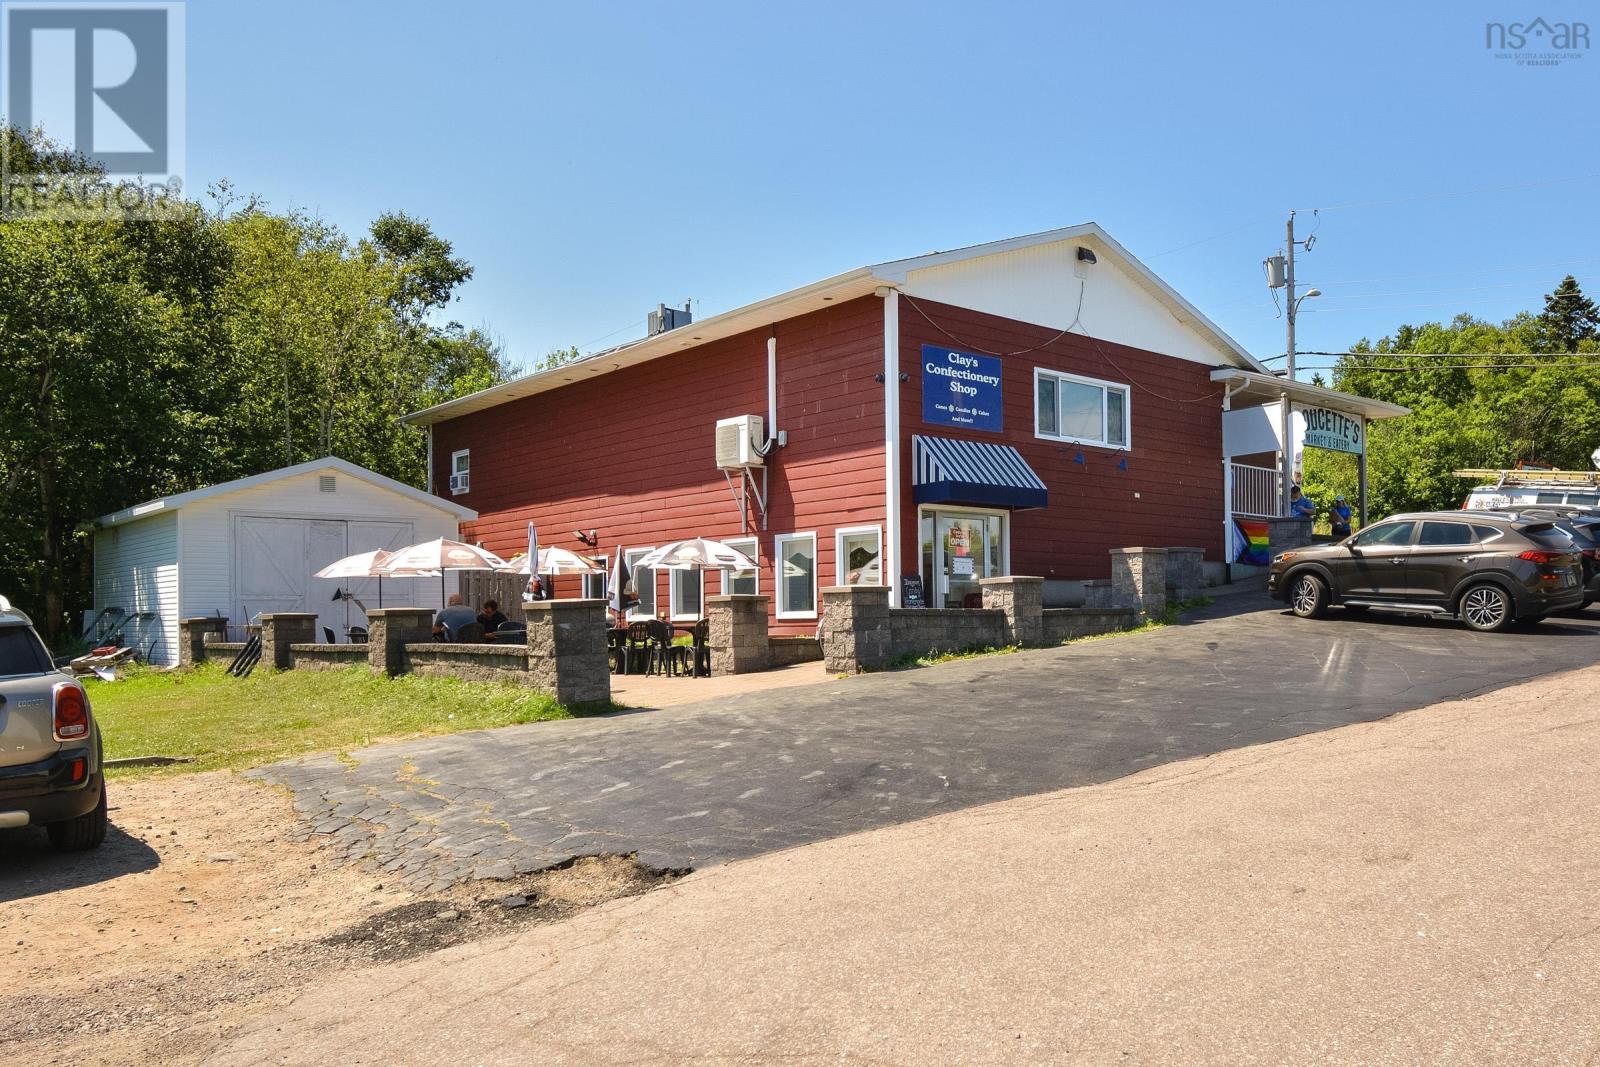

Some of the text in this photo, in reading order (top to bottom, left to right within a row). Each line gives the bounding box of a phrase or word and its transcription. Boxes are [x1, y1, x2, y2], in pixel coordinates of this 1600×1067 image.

[948, 352, 979, 368] Clay's
[926, 363, 1000, 387] Confectionery
[950, 382, 977, 397] Shop
[1333, 438, 1350, 450] EATERY
